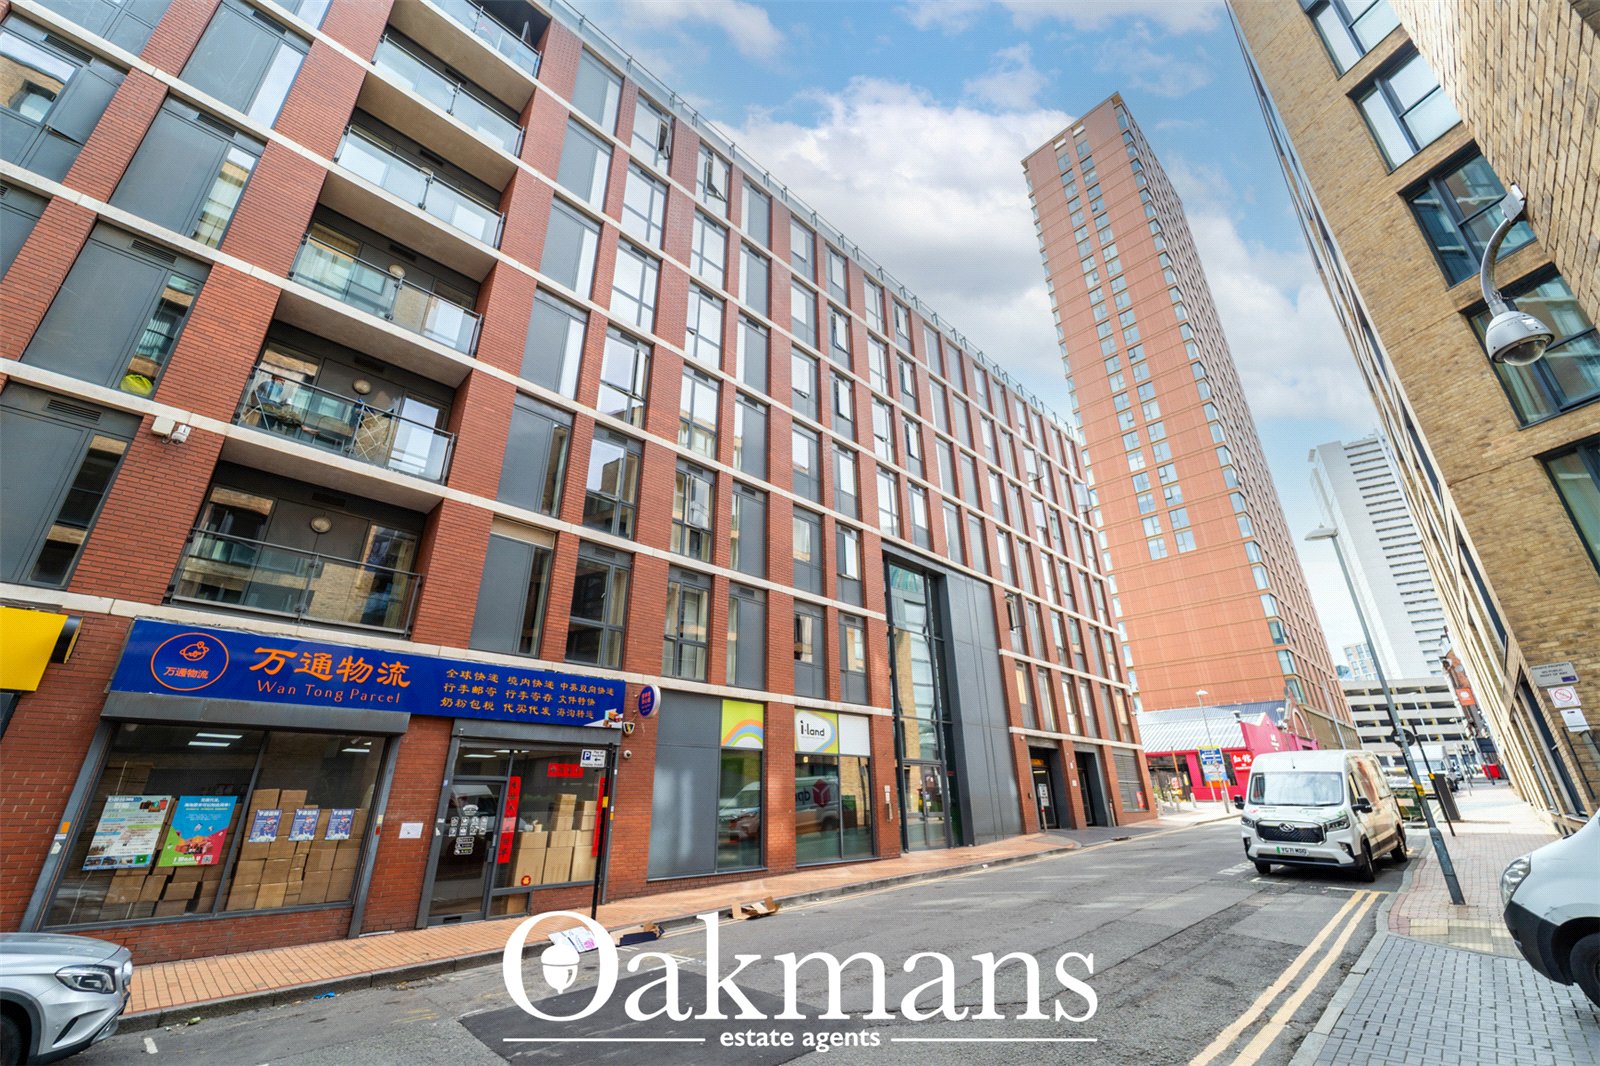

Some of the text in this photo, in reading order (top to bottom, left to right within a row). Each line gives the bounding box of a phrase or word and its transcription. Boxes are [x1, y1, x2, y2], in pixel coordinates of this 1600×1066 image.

[163, 666, 209, 679] 万通物流
[249, 647, 411, 688] 万通物流
[257, 679, 400, 704] Wan Tong Parcel
